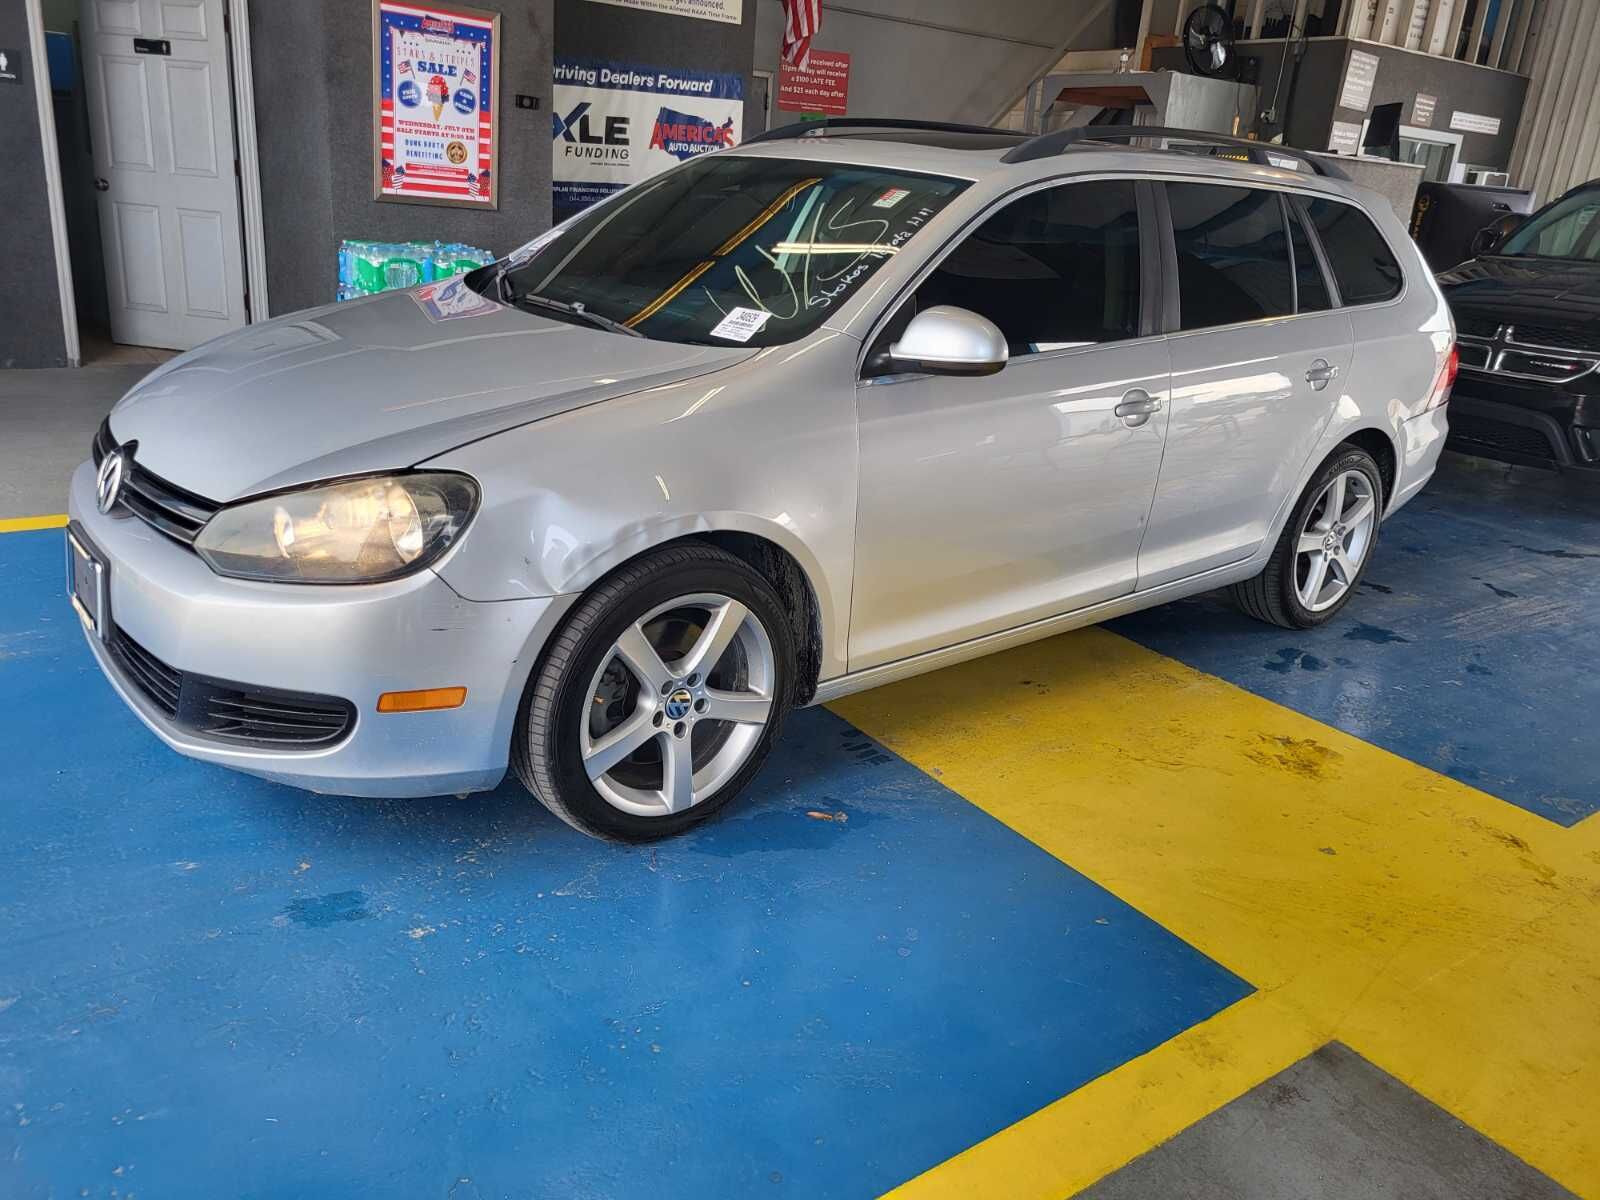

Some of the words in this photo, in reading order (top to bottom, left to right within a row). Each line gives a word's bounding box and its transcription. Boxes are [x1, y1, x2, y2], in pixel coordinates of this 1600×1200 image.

[810, 59, 834, 68] received
[417, 60, 457, 77] SALE
[816, 68, 827, 76] will
[600, 68, 654, 87] Dealers
[657, 74, 713, 93] Forward
[810, 78, 825, 86] LATE
[819, 90, 830, 98] day
[414, 129, 440, 137] STARTS
[668, 141, 688, 152] AUTO
[688, 143, 720, 153] AUCTION
[565, 145, 629, 160] FUNDING
